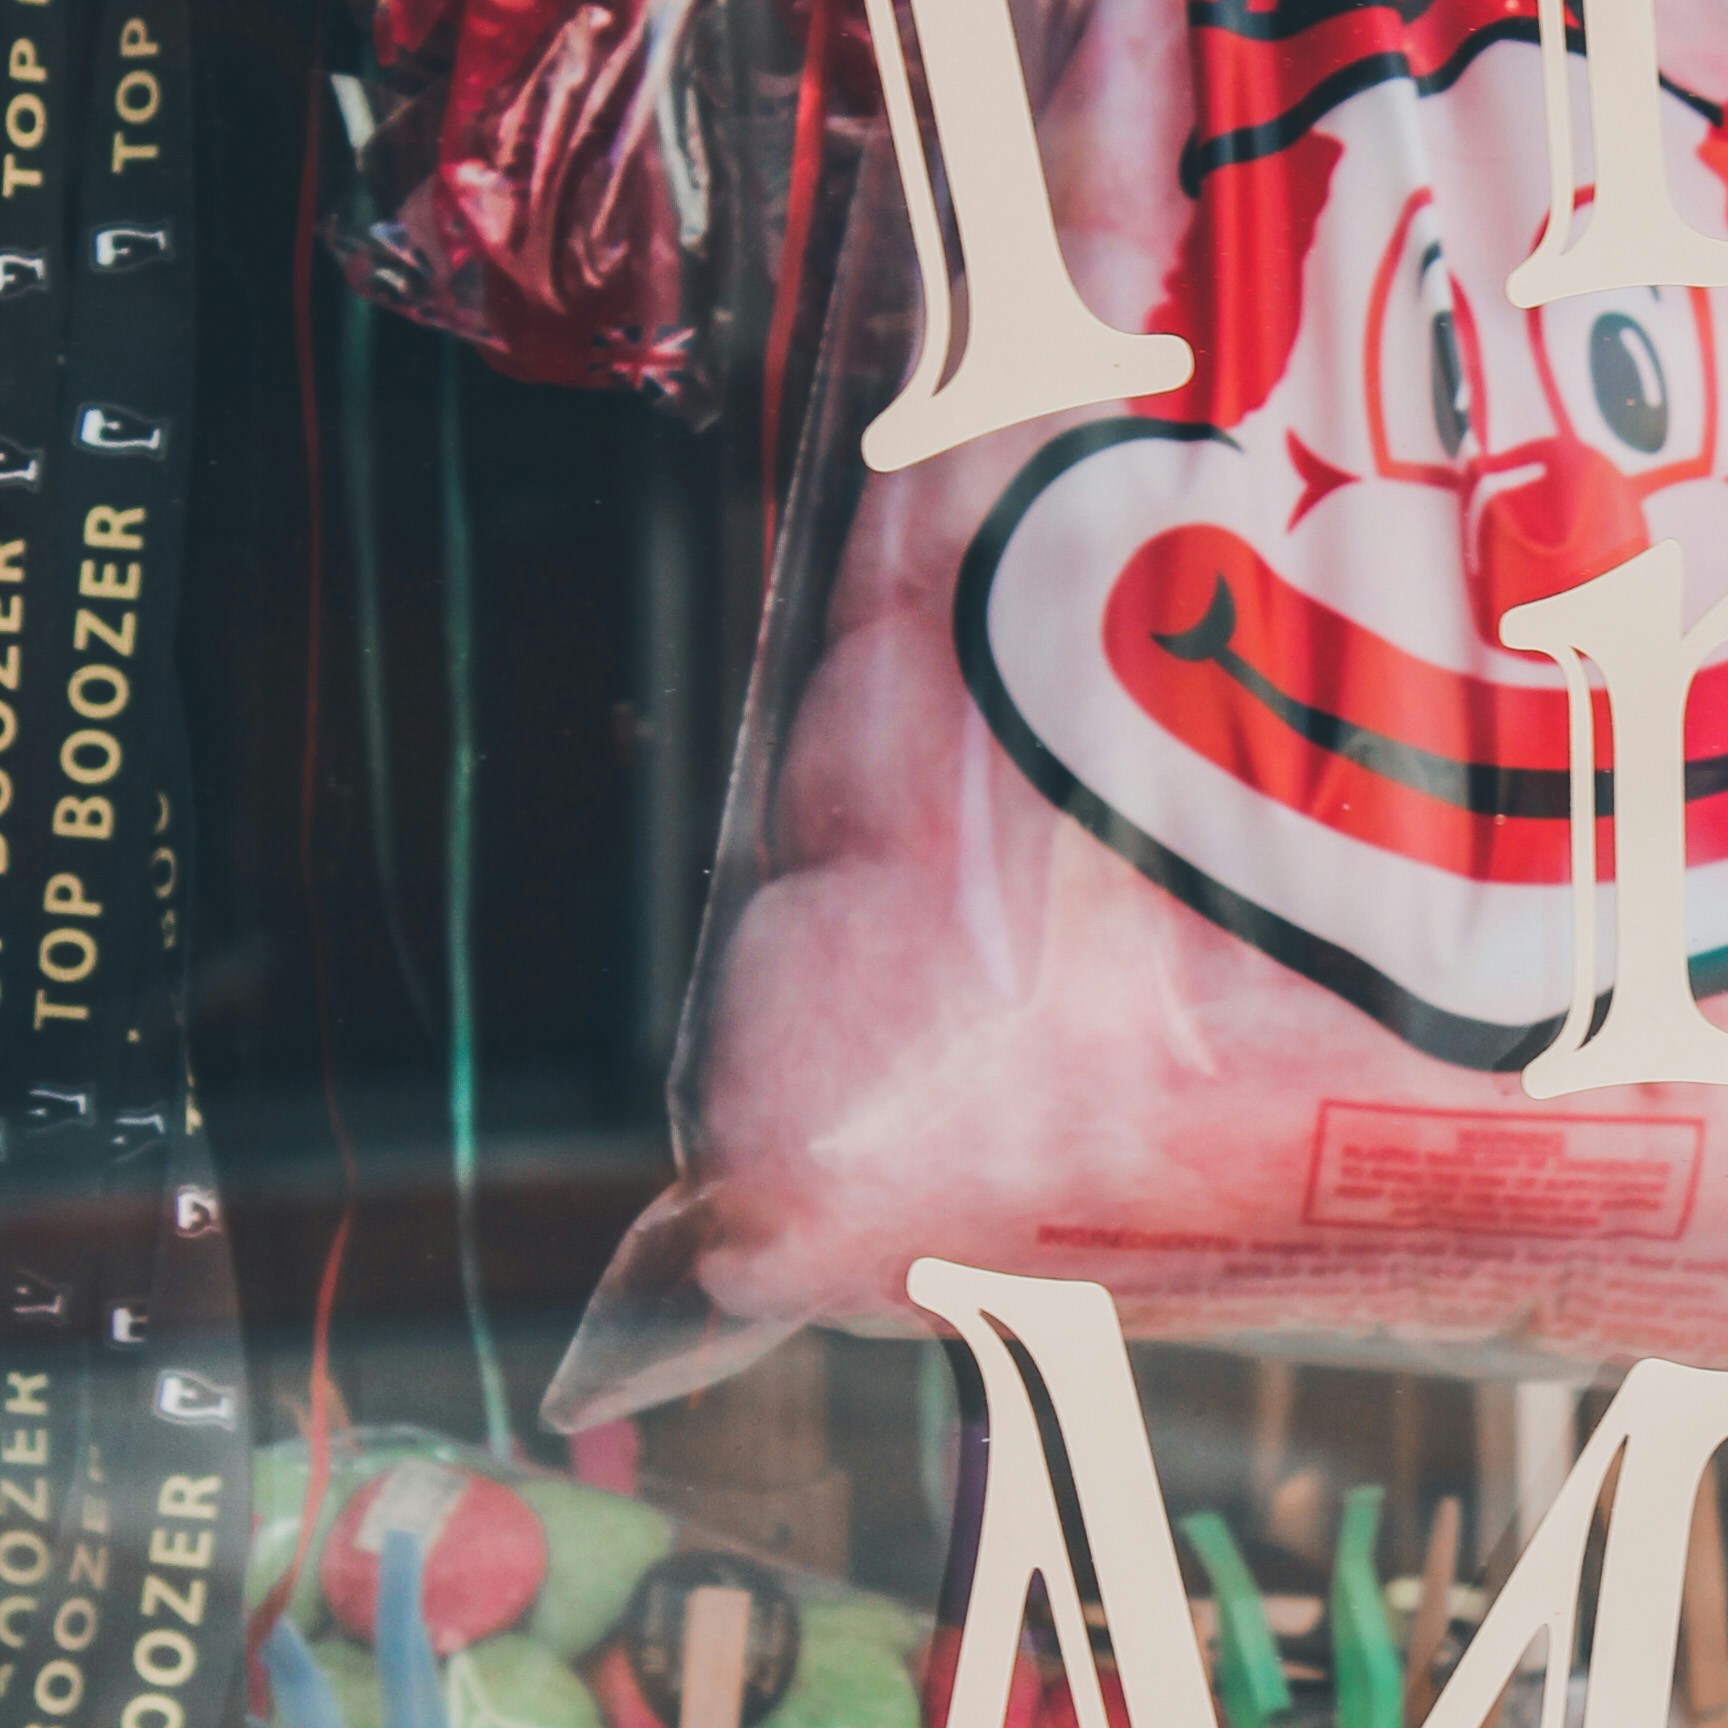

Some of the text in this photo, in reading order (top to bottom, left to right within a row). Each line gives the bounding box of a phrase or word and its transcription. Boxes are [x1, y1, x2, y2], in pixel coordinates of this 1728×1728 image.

[2, 37, 50, 199] TOP
[112, 16, 160, 174] TOP
[33, 504, 147, 1034] TOP BOOZER
